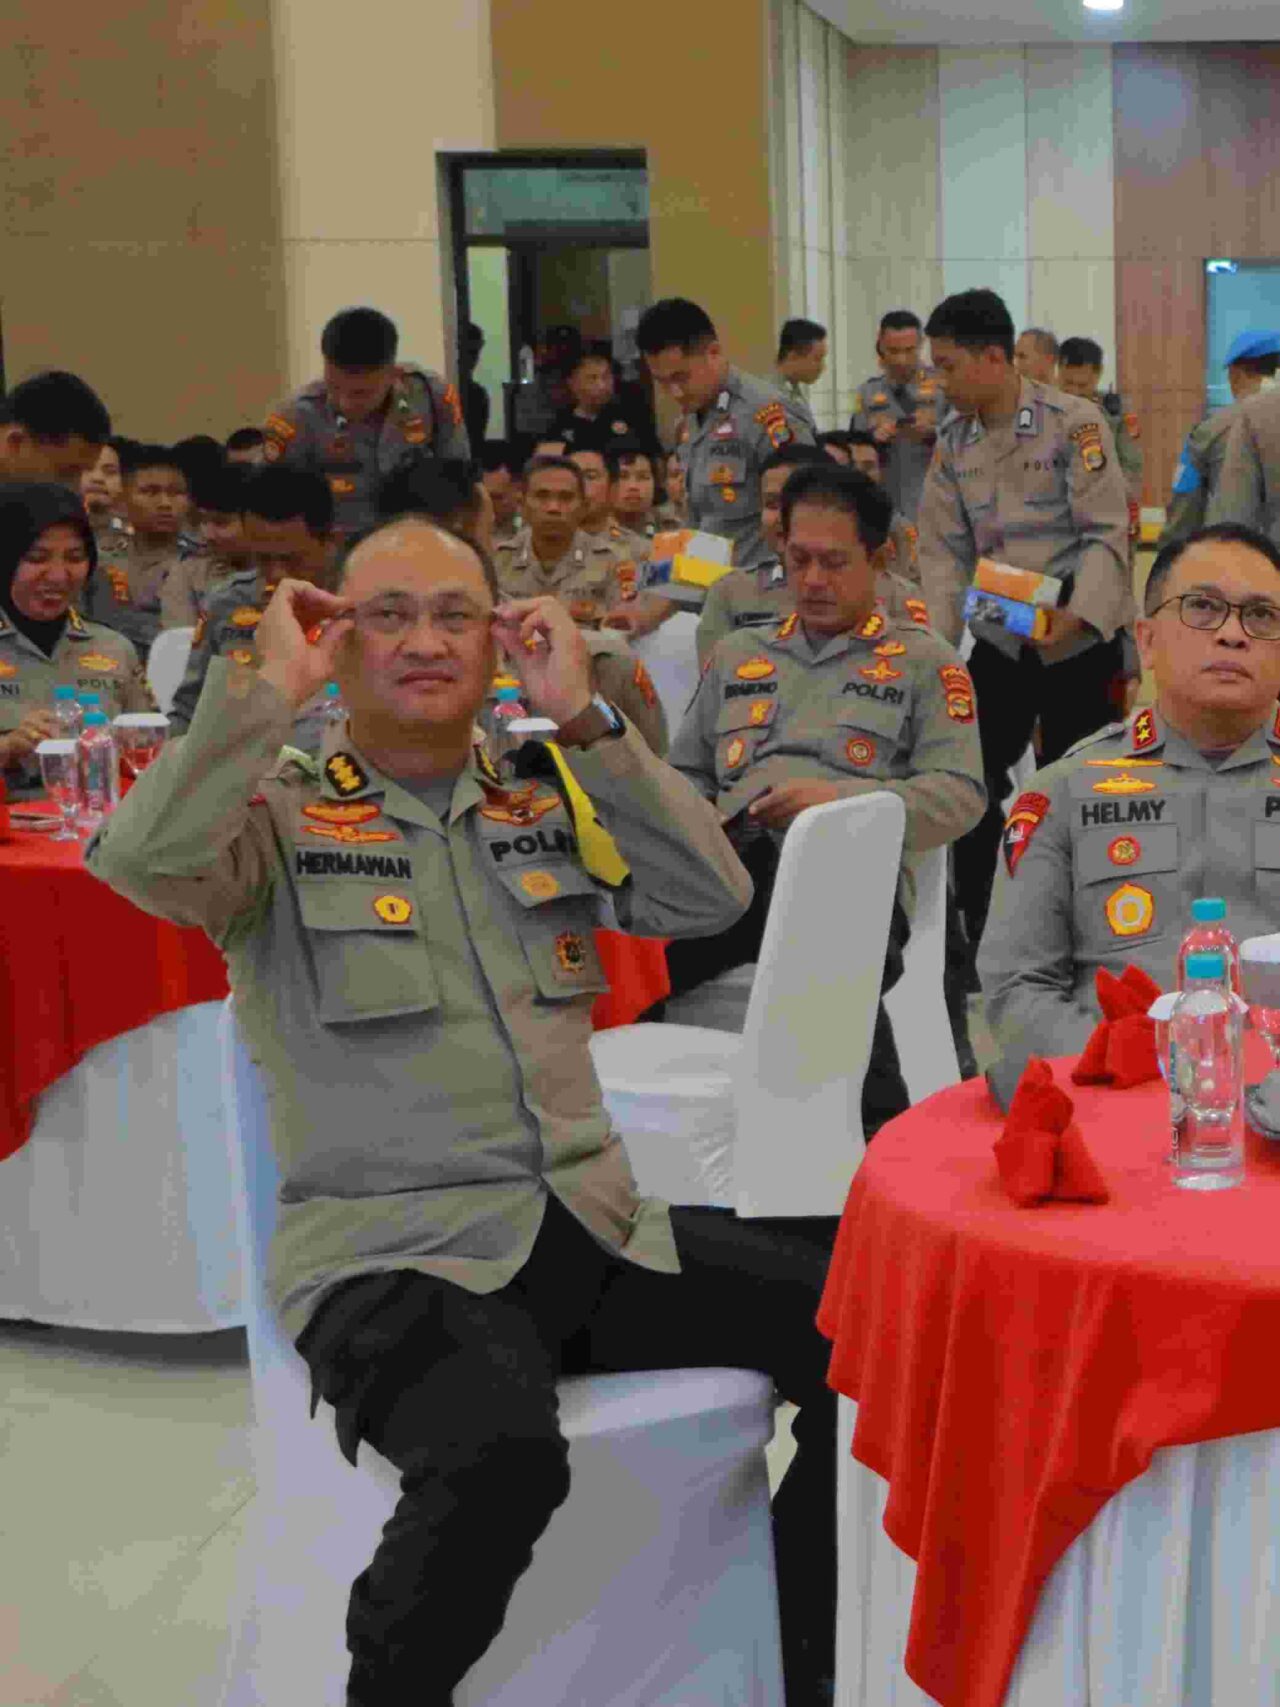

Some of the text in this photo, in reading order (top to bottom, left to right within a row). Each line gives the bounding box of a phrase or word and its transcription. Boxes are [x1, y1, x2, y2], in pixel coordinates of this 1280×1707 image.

[842, 682, 905, 704] POLRI
[1081, 799, 1167, 826] HELMY
[296, 850, 412, 879] HERMAWAN
